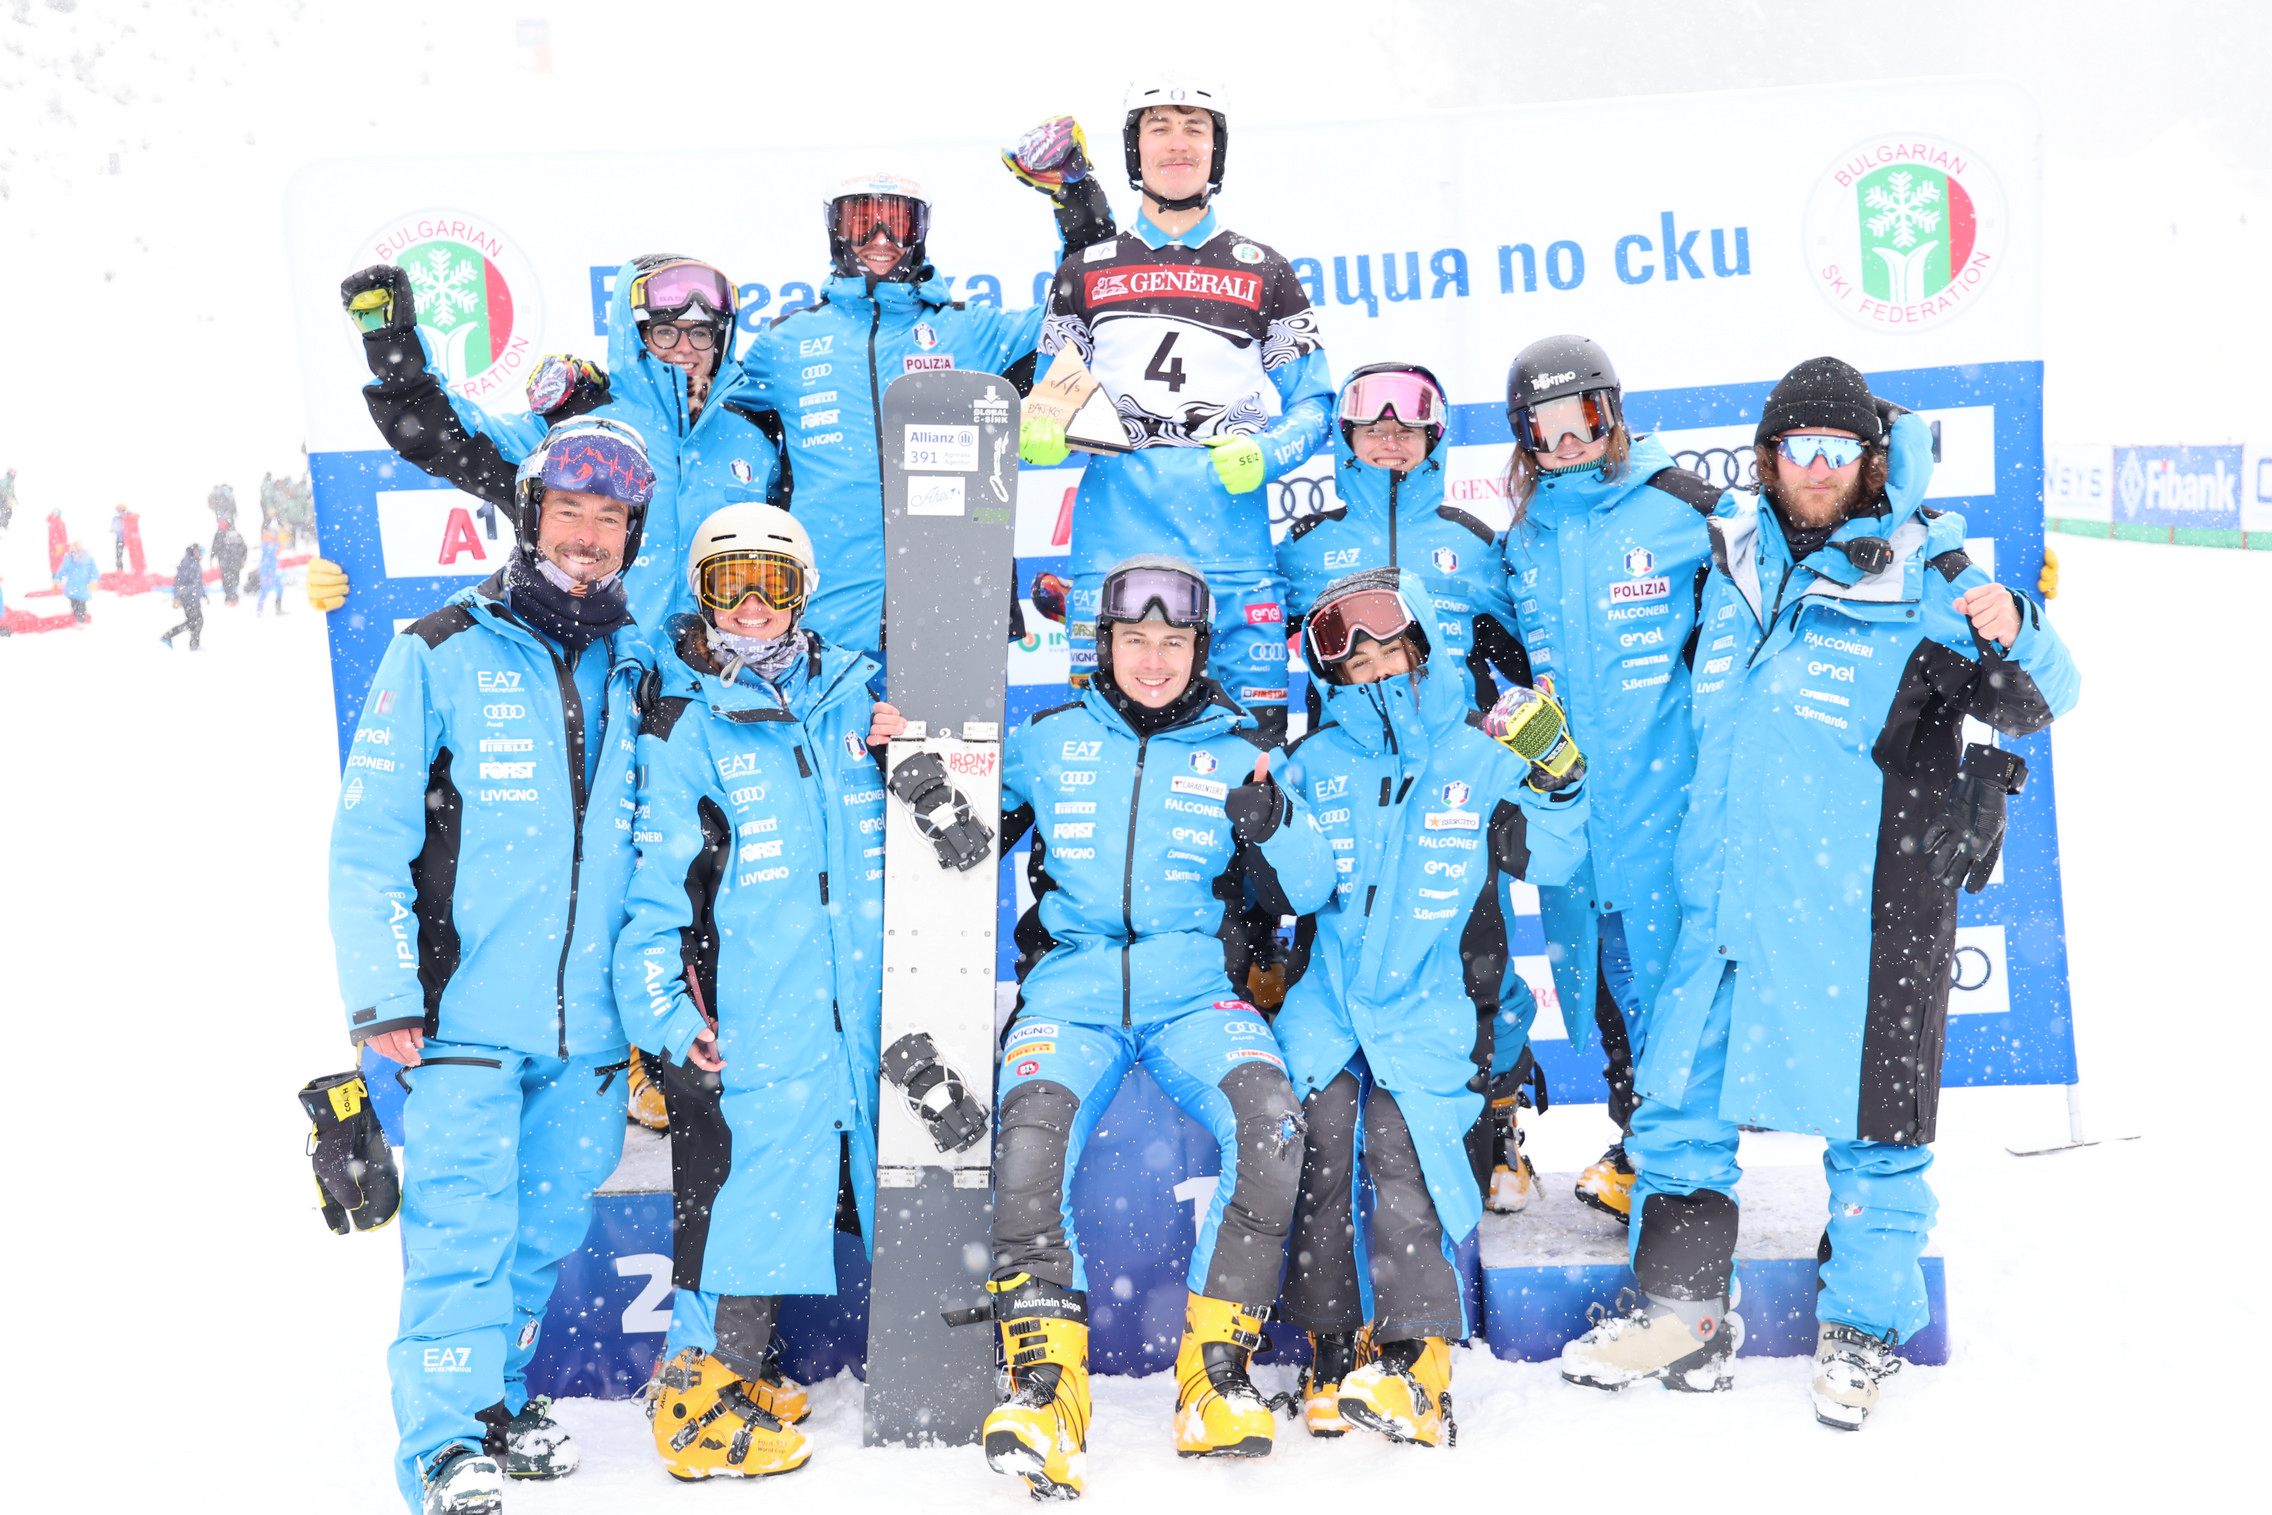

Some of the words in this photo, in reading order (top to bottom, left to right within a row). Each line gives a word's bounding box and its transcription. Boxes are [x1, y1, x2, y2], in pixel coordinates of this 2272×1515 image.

[1834, 144, 1968, 187] BULGARIAN
[375, 219, 504, 260] BULGARIAN
[1614, 211, 1751, 285] ски
[1130, 271, 1257, 303] GENERALI
[1822, 264, 1852, 299] SKI
[1858, 251, 1991, 323] FEDERATION
[800, 335, 834, 354] EA7
[450, 336, 530, 399] ERATION
[906, 358, 951, 370] POLIZIA
[1144, 332, 1186, 392] 4
[801, 409, 840, 429] FORST
[973, 408, 1009, 416] GLOBAL
[802, 432, 843, 448] LIVIGNO
[911, 432, 954, 443] Allianz
[911, 451, 938, 464] 391
[2146, 459, 2236, 512] Fibank
[439, 501, 498, 565] A1
[1324, 548, 1361, 566] EA7
[1614, 582, 1666, 598] POLIZIA
[1251, 606, 1280, 621] enel
[1431, 599, 1469, 612] CONERI
[1608, 604, 1669, 620] FALCONERI
[1439, 620, 1462, 635] nel
[1620, 627, 1663, 647] enel
[1804, 632, 1873, 658] FALCONERI
[478, 671, 521, 687] EA7
[1808, 661, 1854, 682] enel
[1252, 690, 1287, 698] FINSTRA
[1794, 705, 1848, 729] S.Bernardo
[354, 727, 389, 745] enel
[480, 739, 534, 752] PIRELLI
[1062, 741, 1103, 756] EA7
[348, 755, 395, 772] CONERI
[718, 753, 756, 776] EA7
[950, 752, 986, 765] IRON
[480, 762, 536, 779] FORST
[950, 762, 987, 777] ROCK
[481, 788, 538, 801] LIVIGNO
[1182, 781, 1224, 796] CARABINIERI
[1315, 776, 1348, 798] EA7
[1054, 802, 1097, 814] PIRELLI
[1053, 822, 1096, 839] FORST
[1441, 818, 1476, 827] ESERCITO
[633, 831, 663, 842] ONERI
[1172, 827, 1215, 846] enel
[740, 840, 784, 864] FORST
[740, 866, 789, 887] LIVIGNO
[1424, 861, 1467, 877] enel
[389, 900, 416, 969] Audi
[1006, 1027, 1054, 1047] LIVIGNO
[343, 1088, 351, 1112] COH
[615, 1253, 674, 1334] 2
[1014, 1298, 1060, 1309] Mountain
[1062, 1299, 1081, 1313] Slope
[424, 1348, 472, 1366] EA7
